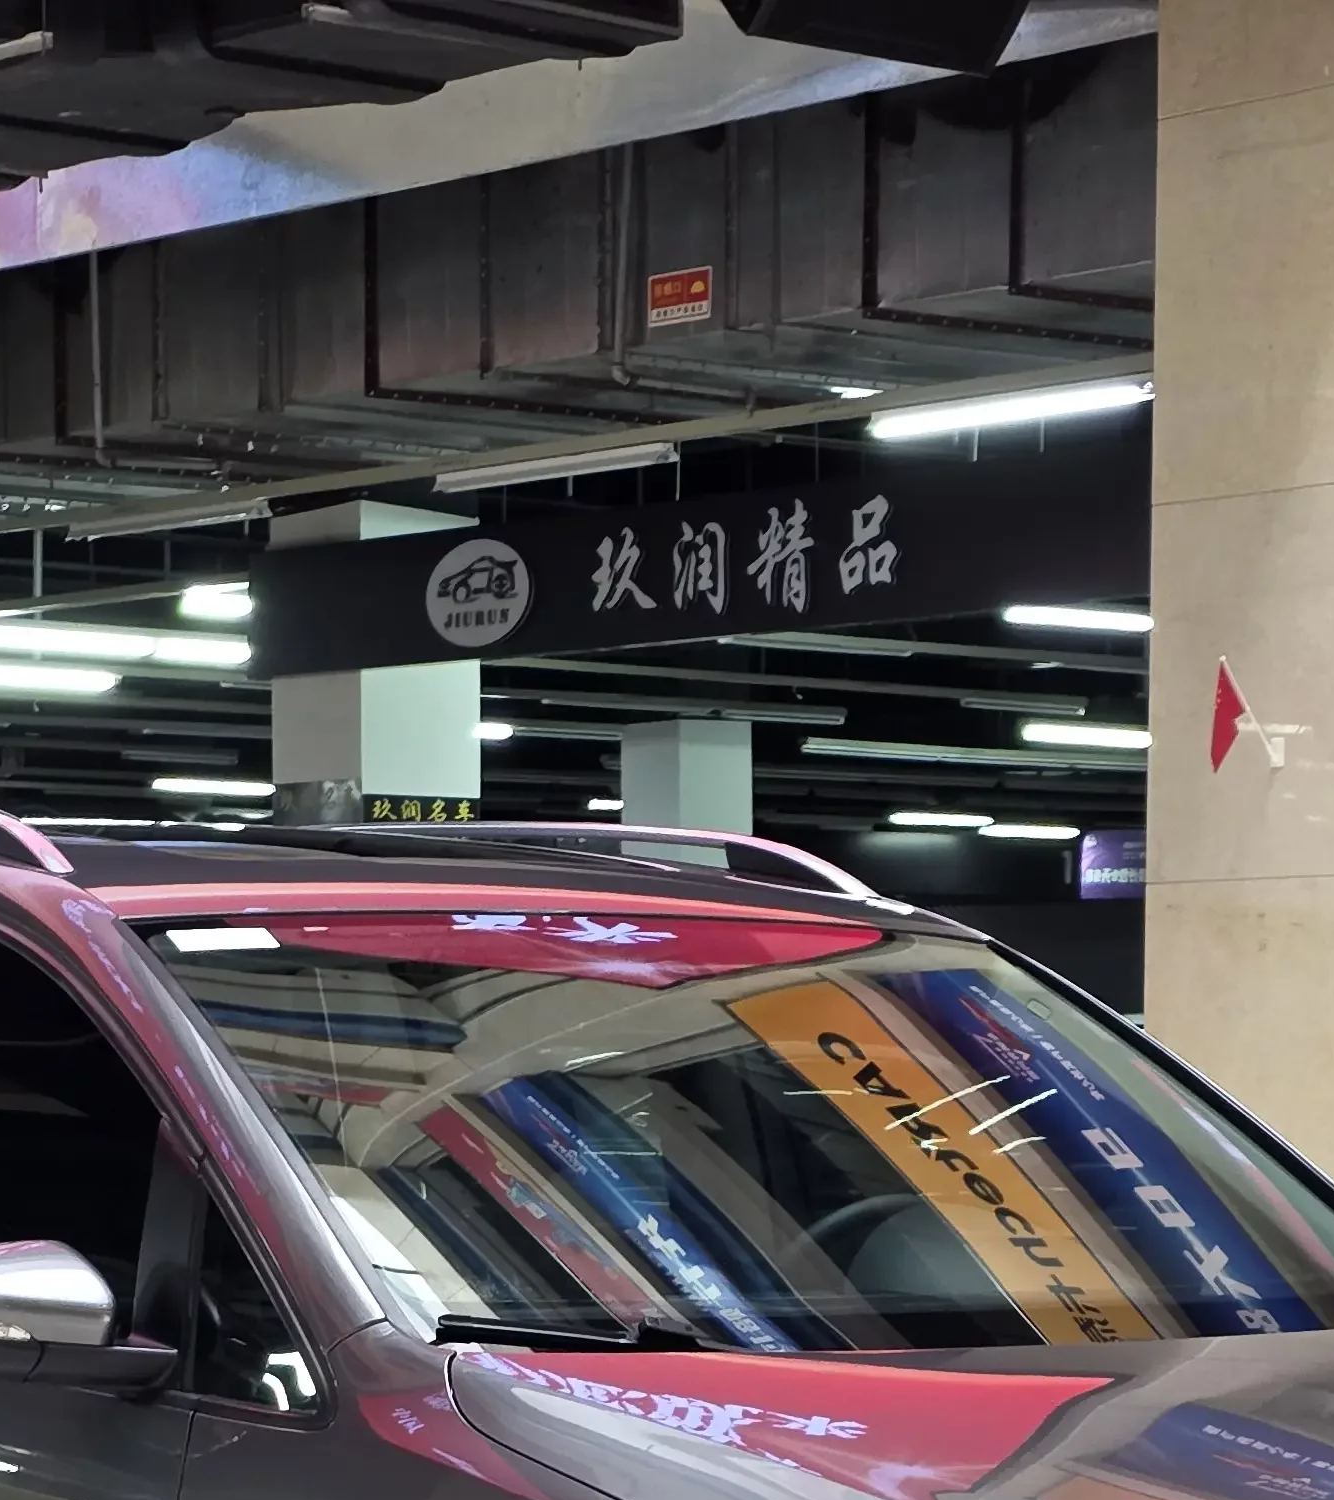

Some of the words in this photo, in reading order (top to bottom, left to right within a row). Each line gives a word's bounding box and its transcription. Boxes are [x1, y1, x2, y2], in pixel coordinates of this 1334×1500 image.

[591, 494, 901, 614] 玖润精品
[372, 798, 475, 823] 玖润名车
